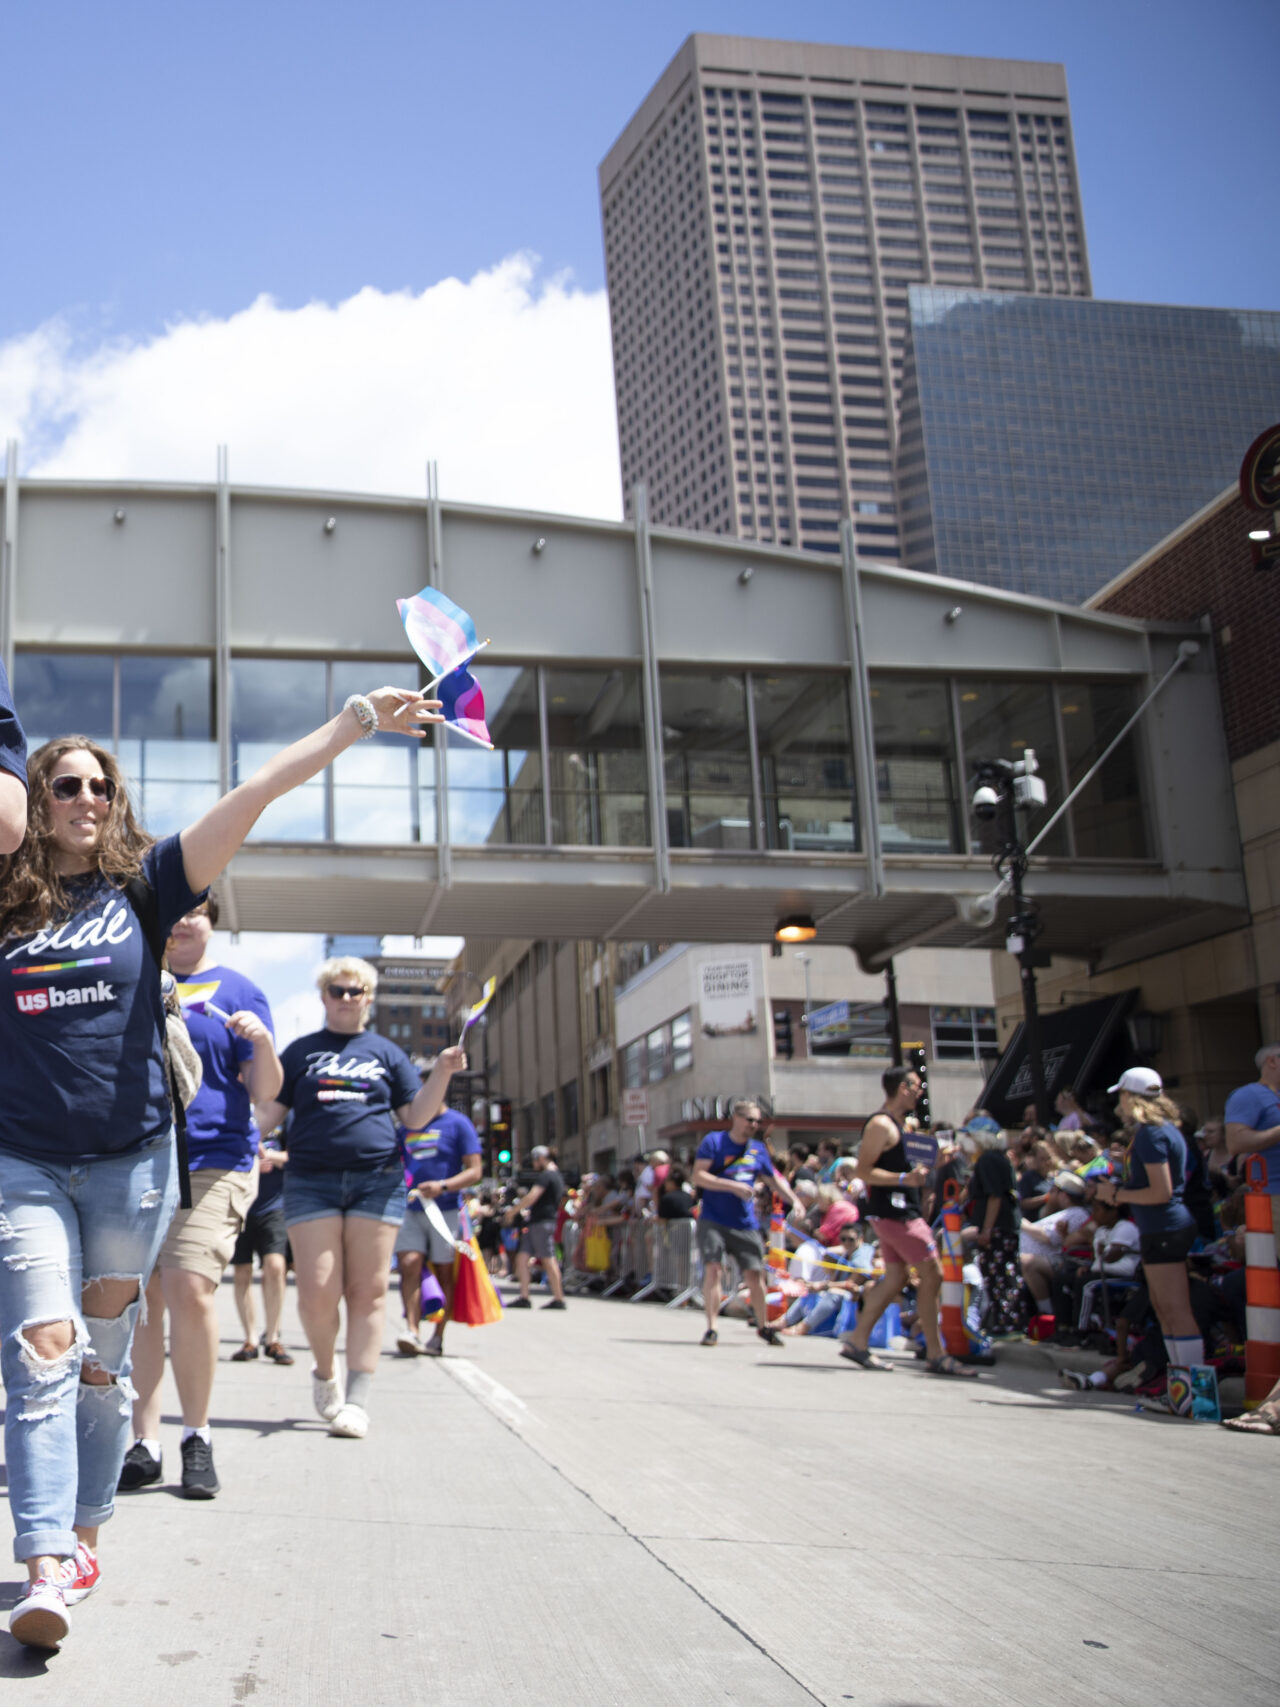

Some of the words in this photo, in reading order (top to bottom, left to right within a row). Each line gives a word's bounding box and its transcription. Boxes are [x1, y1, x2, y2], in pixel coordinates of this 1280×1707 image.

[17, 980, 115, 1012] usbank
[703, 979, 749, 992] DINING
[305, 1051, 386, 1080] Pride
